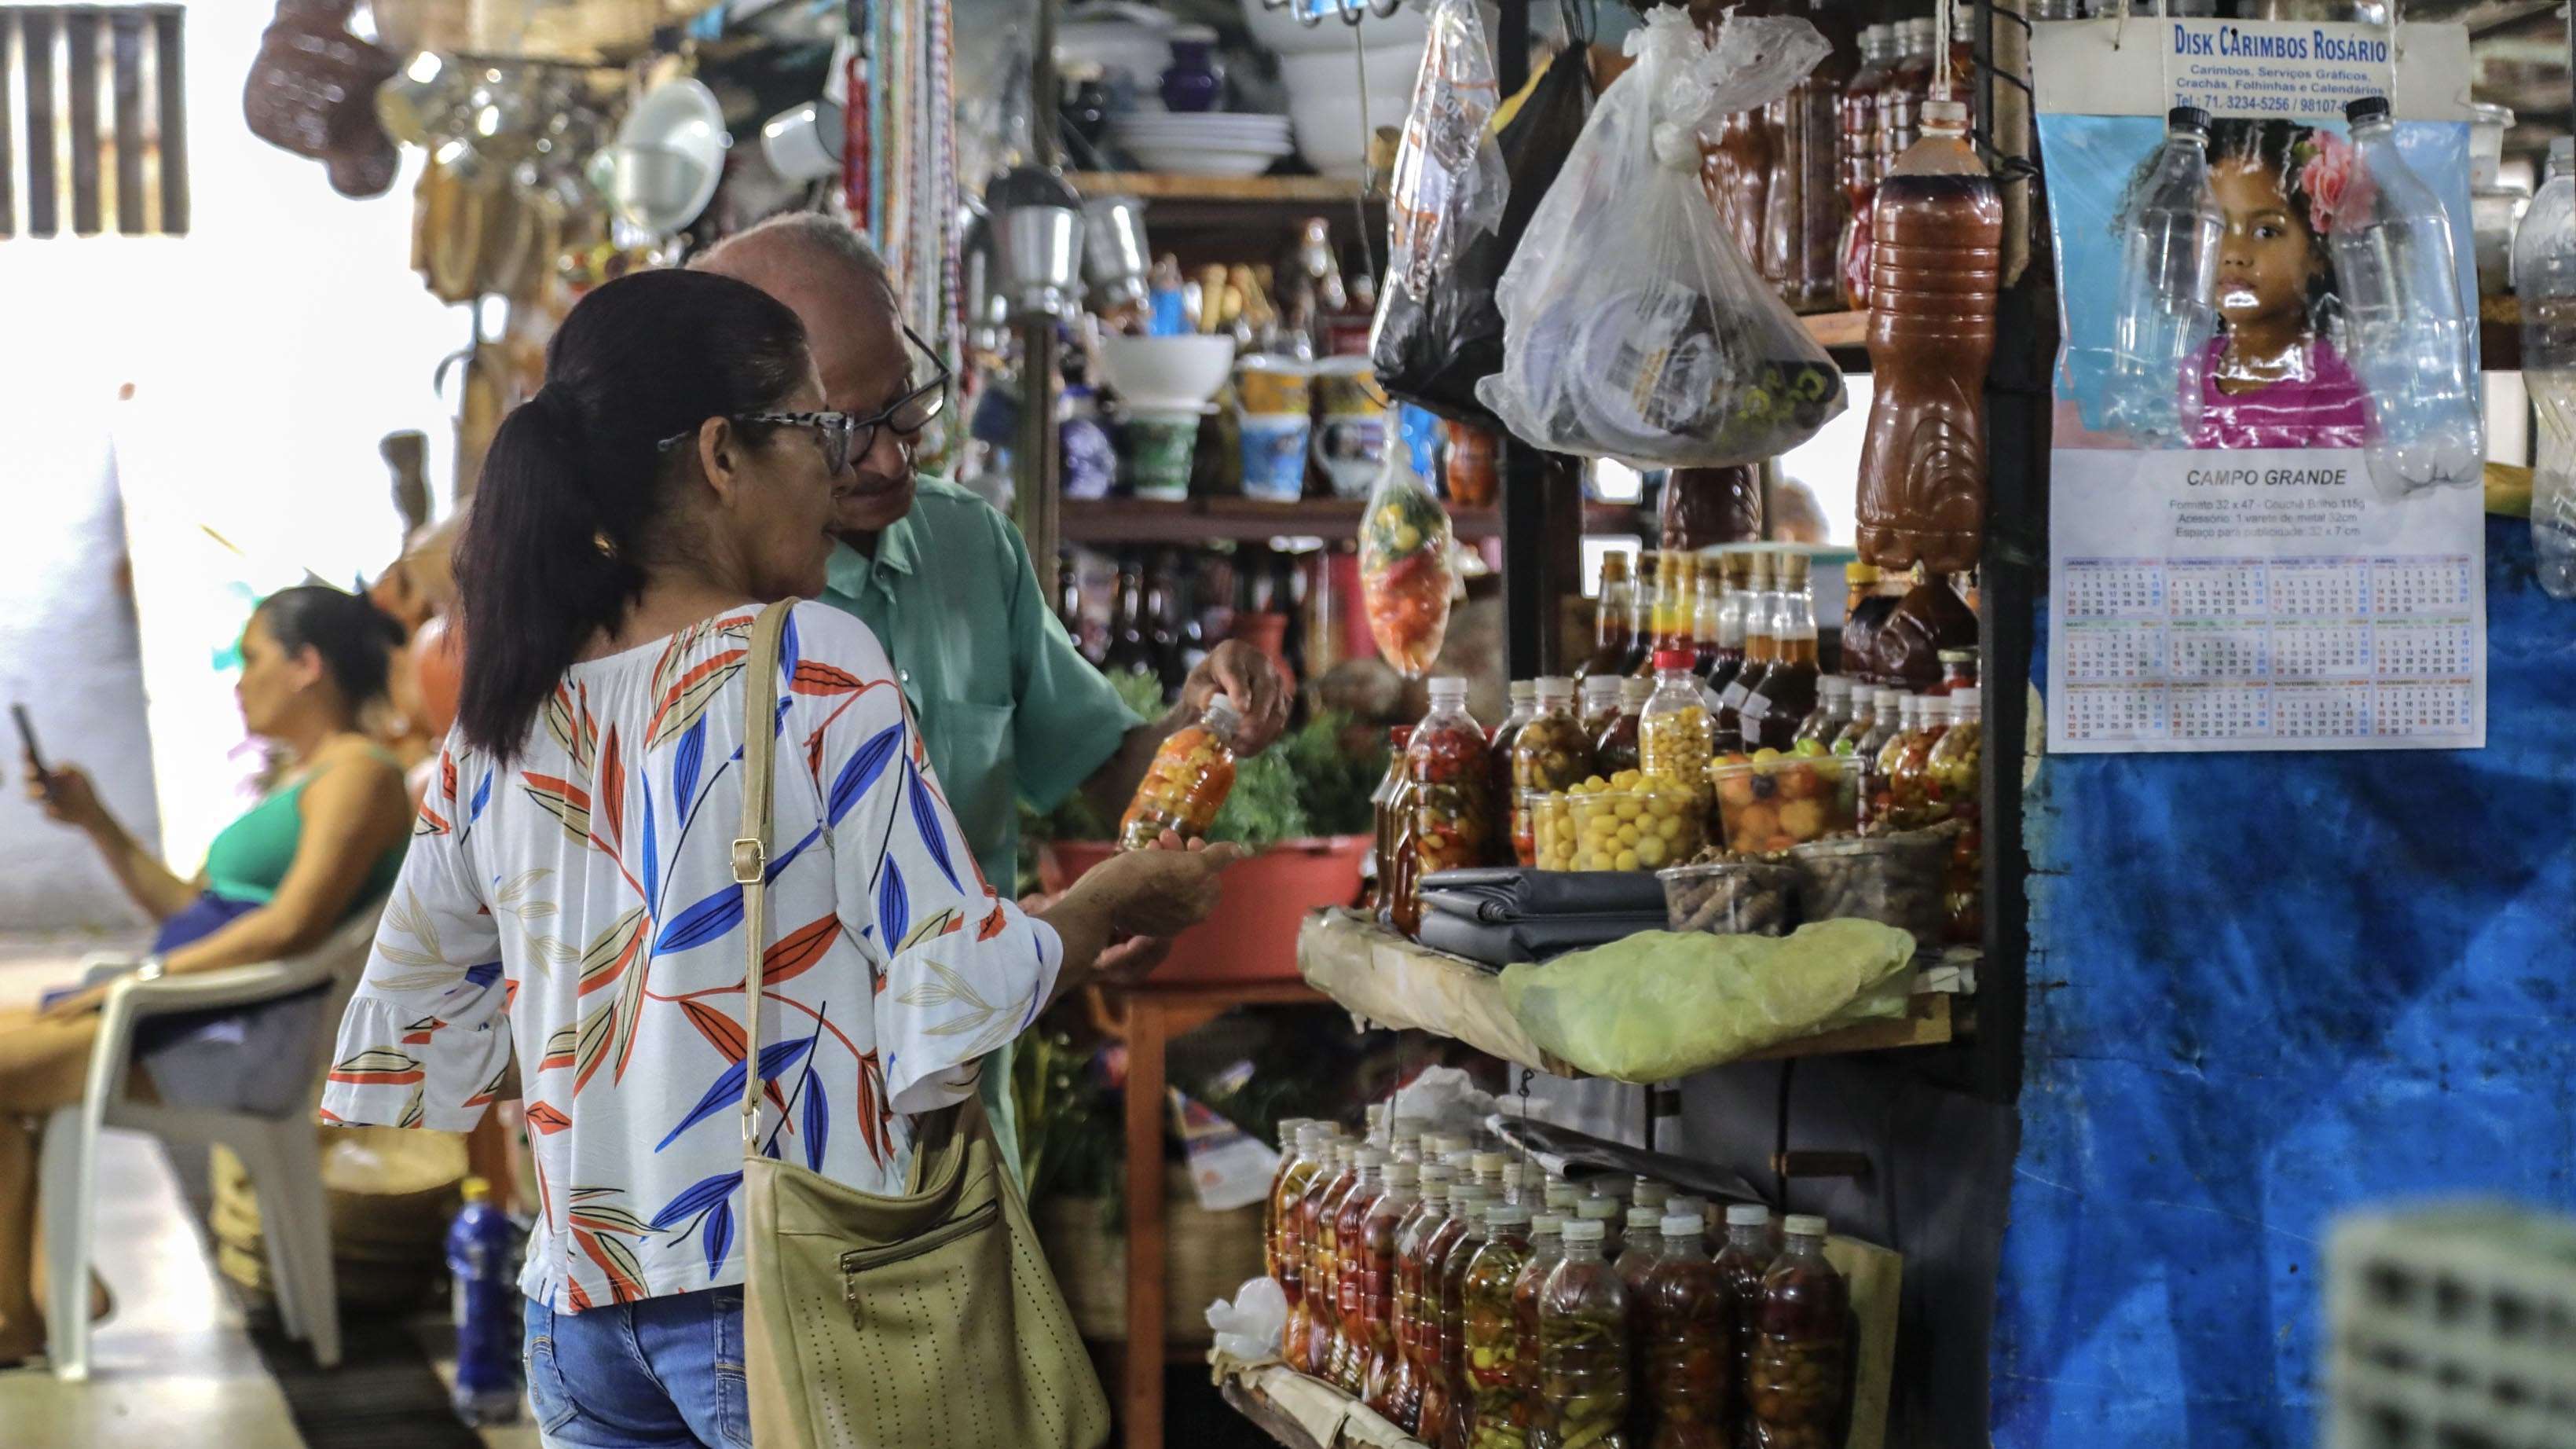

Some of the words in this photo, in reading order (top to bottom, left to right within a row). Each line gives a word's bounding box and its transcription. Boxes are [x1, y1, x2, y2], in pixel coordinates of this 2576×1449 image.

[2191, 64, 2253, 77] Carimbos,
[2259, 68, 2311, 79] Serviços
[2176, 78, 2231, 90] Crachás,
[2235, 81, 2295, 93] Folhinhas
[2311, 82, 2384, 95] Calendários
[2227, 96, 2289, 111] 3234-5256
[2187, 470, 2258, 486] CAMPO
[2264, 469, 2347, 485] GRANDE
[2170, 500, 2213, 509] Formato
[2216, 500, 2229, 509] 32
[2241, 500, 2254, 509] 47
[2341, 499, 2365, 511] 115g
[2281, 513, 2294, 523] de
[2298, 513, 2325, 523] metal
[2175, 527, 2214, 538] Espaço
[2218, 529, 2239, 538] para
[2336, 526, 2341, 535] 7
